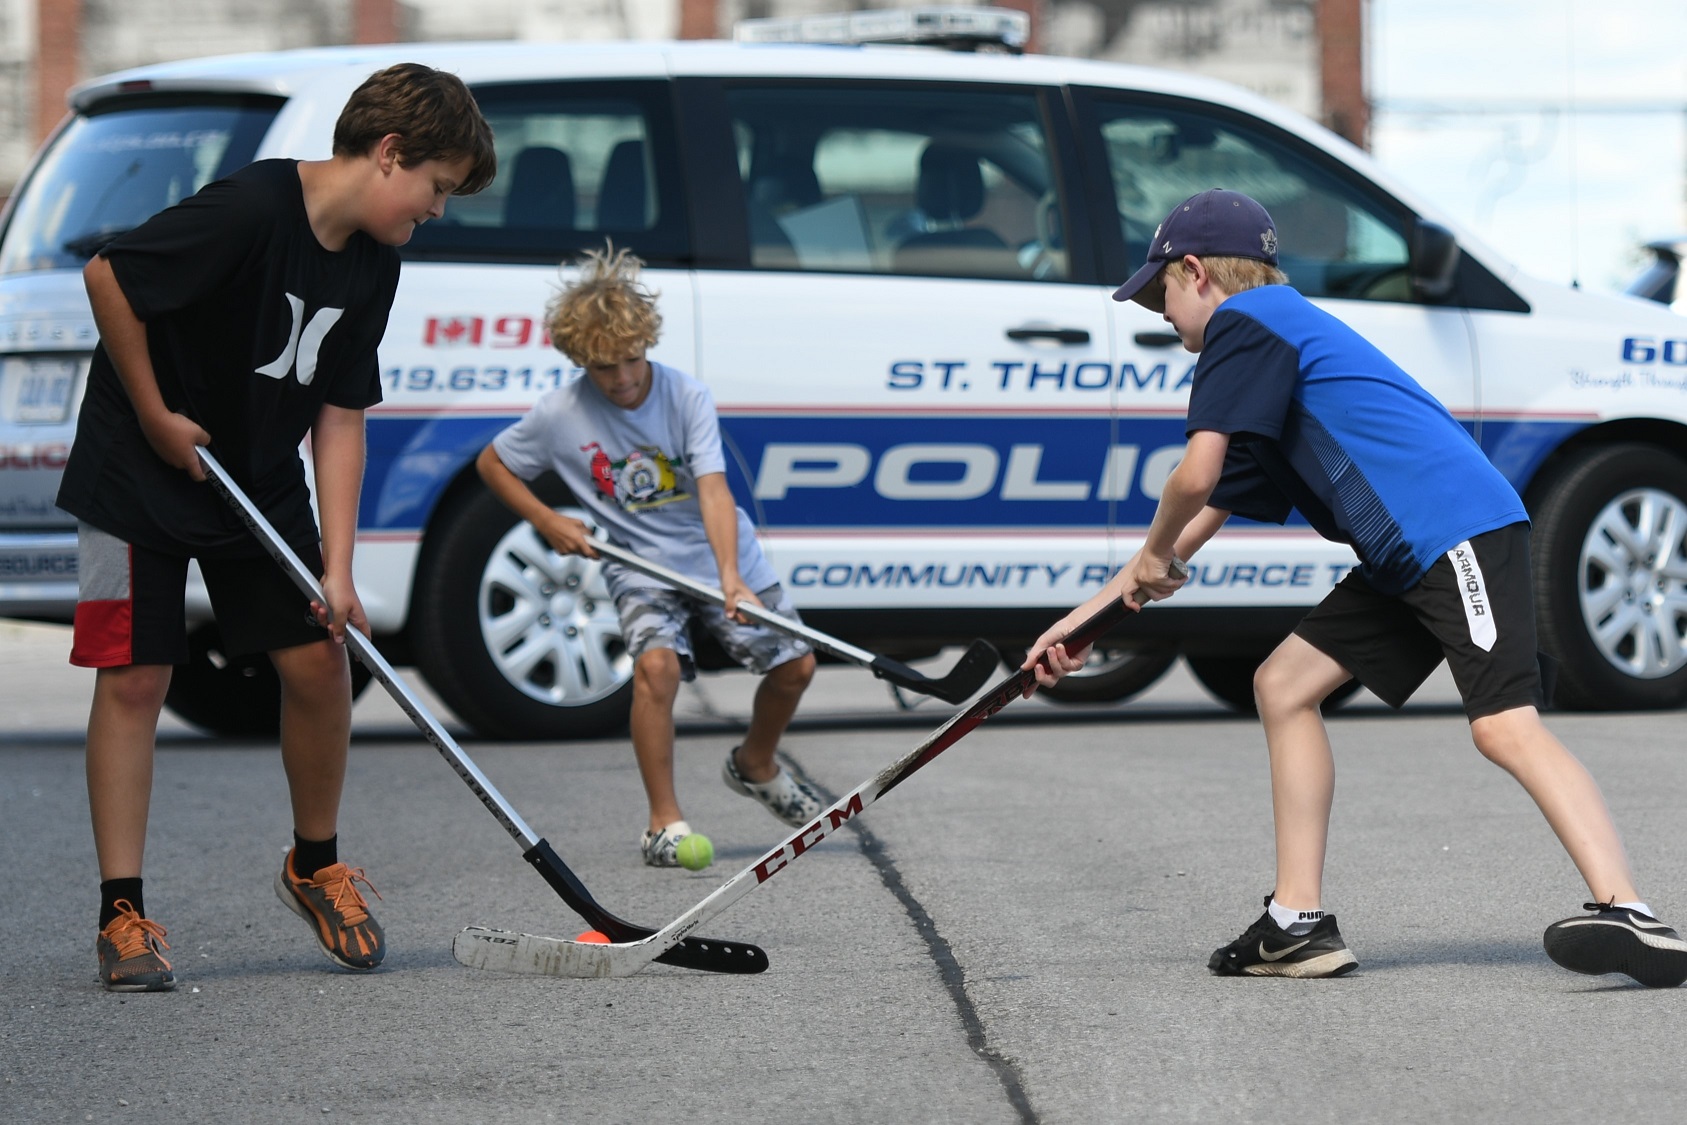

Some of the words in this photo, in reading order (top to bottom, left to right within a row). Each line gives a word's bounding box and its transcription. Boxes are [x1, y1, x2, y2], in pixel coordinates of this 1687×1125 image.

[885, 360, 970, 392] ST.
[789, 562, 1071, 588] COMMUNITY
[1078, 562, 1315, 588] RURCE
[1453, 548, 1485, 617] ARMOUR
[750, 792, 863, 884] CCM
